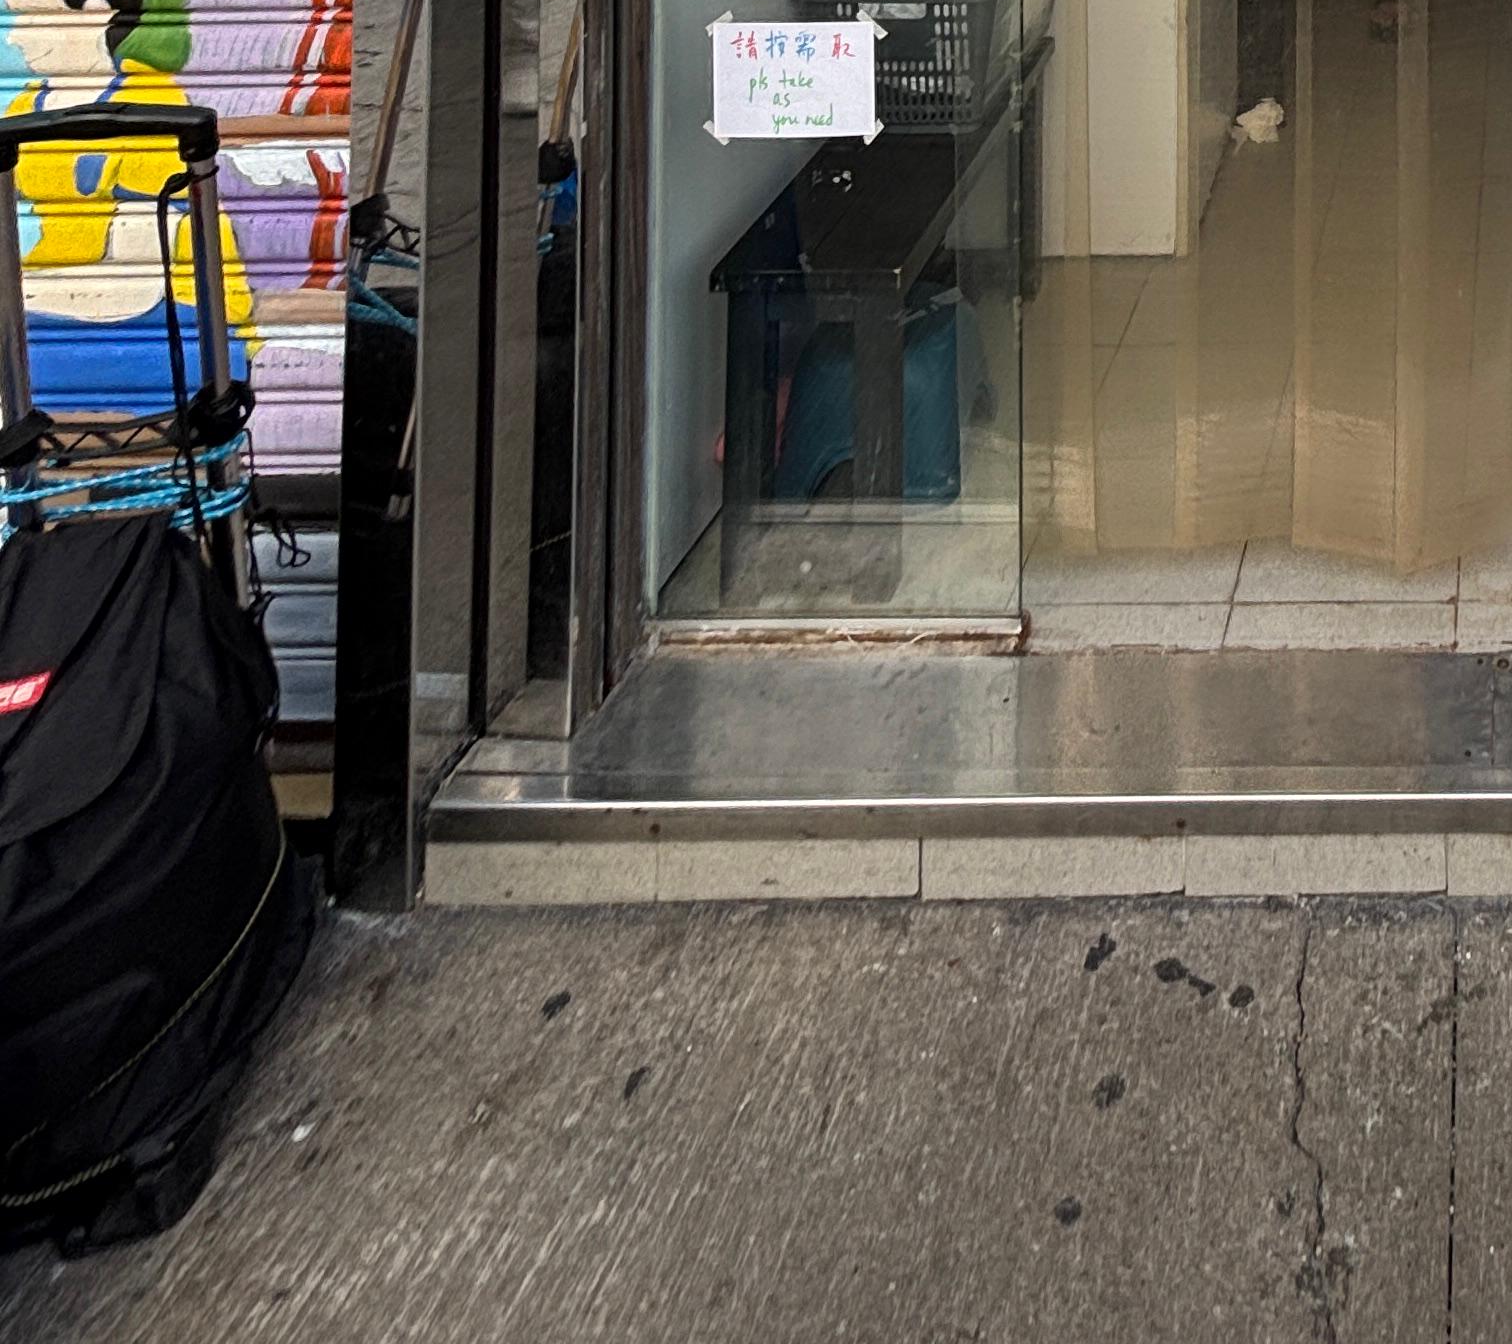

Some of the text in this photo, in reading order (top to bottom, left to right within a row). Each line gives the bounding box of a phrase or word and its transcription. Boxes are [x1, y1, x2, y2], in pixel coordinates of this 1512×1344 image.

[749, 66, 814, 103] pls take
[773, 92, 790, 108] as
[772, 103, 833, 134] you need
